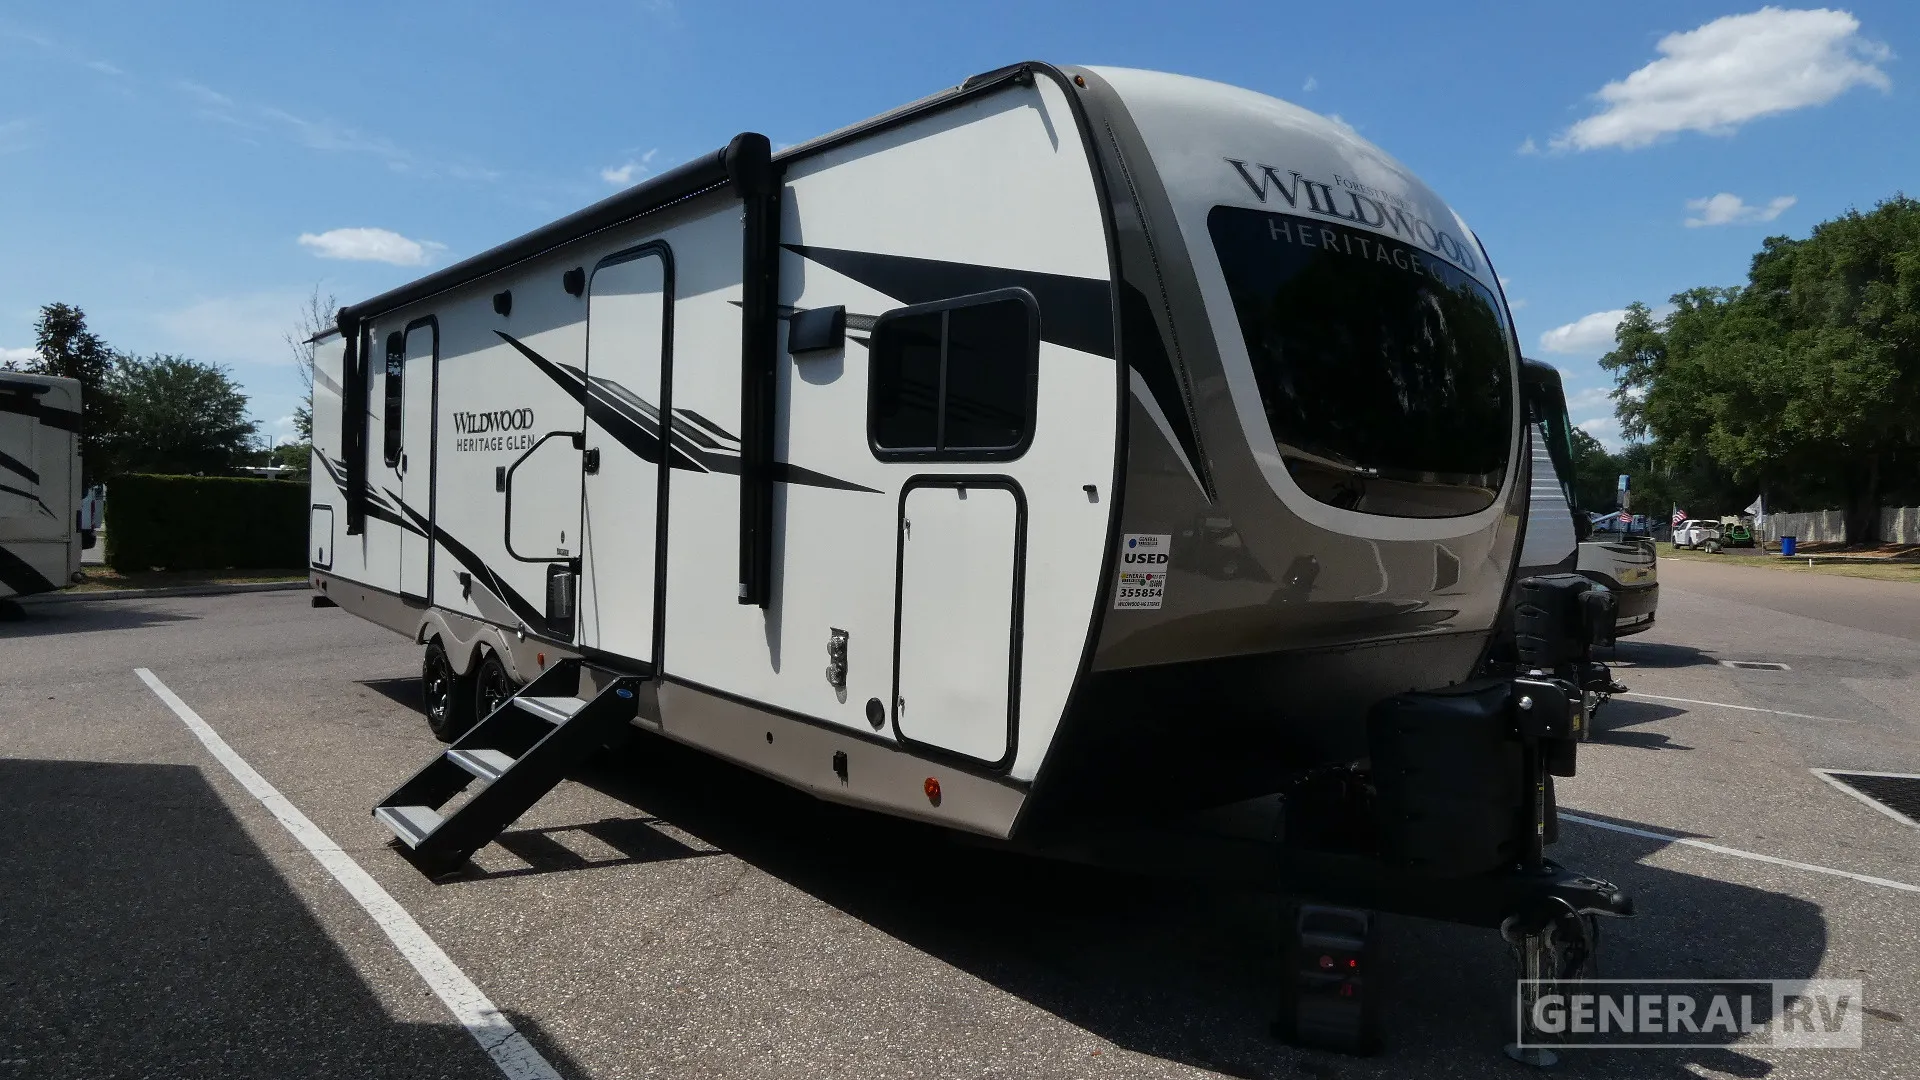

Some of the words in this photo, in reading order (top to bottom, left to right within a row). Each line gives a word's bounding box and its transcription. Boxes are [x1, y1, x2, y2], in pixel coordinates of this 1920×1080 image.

[1223, 157, 1477, 273] WILDWOOD
[1267, 218, 1424, 275] HERITAGE
[453, 407, 534, 435] WILDWOOD
[456, 437, 503, 452] HERITAGE
[506, 434, 535, 451] GLEN
[1124, 553, 1169, 564] USED
[1119, 588, 1163, 598] 355854
